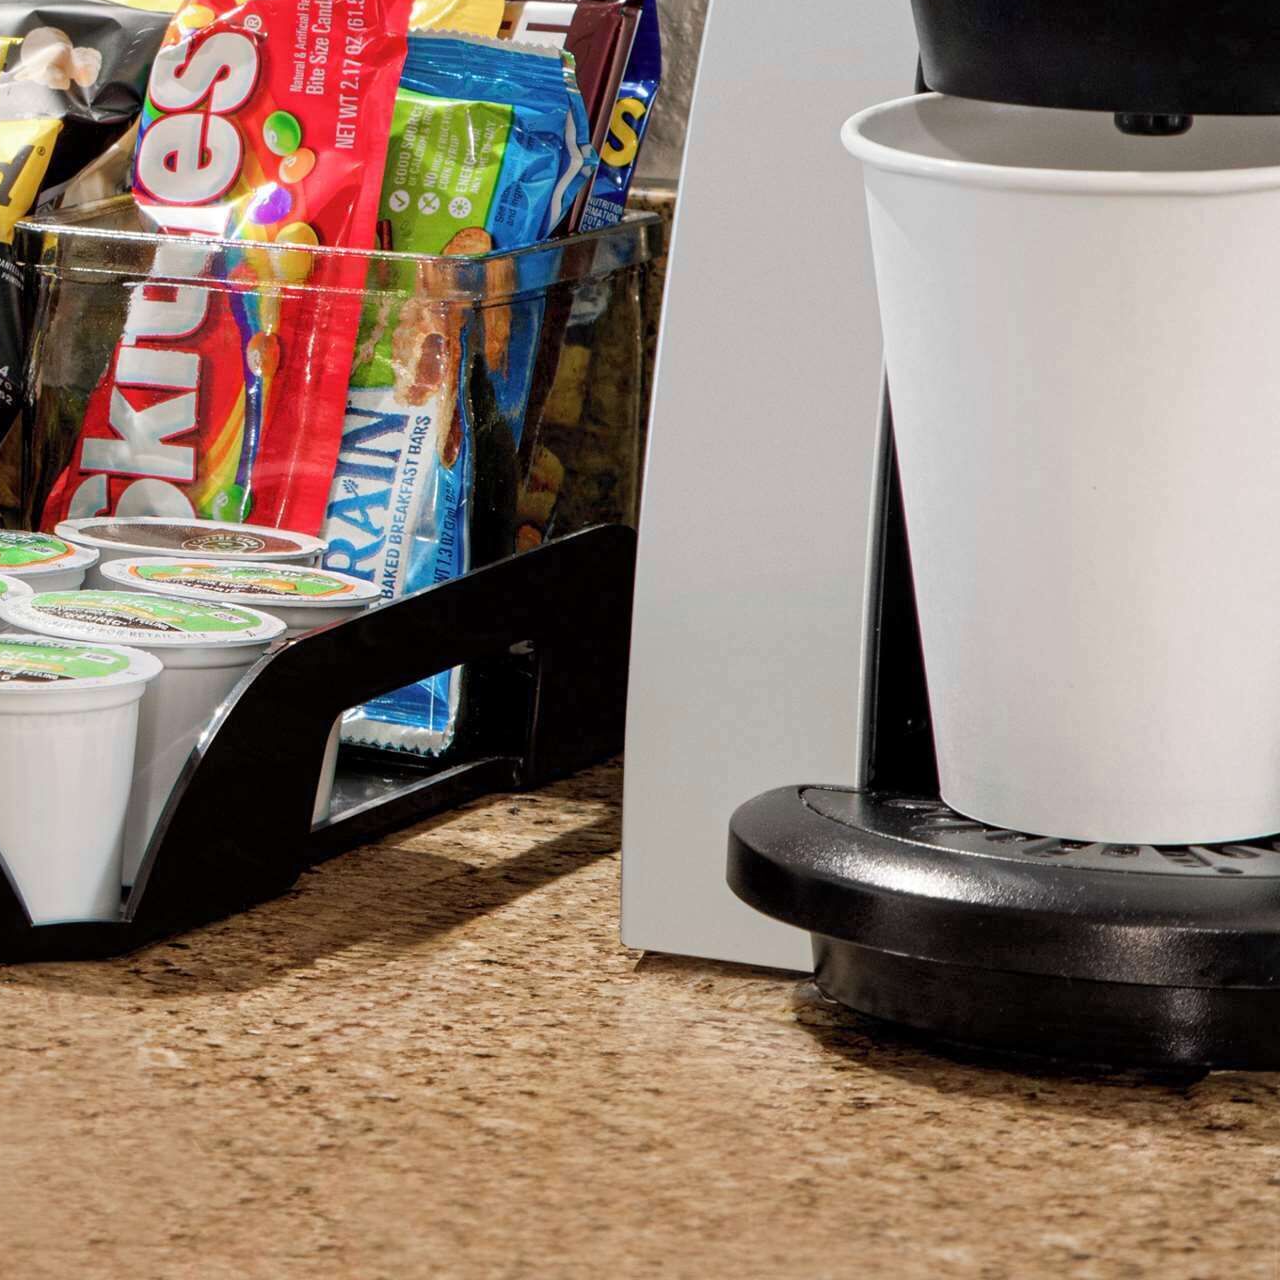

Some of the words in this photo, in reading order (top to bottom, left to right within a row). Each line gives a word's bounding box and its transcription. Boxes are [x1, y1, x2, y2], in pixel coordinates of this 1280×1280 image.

[310, 37, 329, 65] Size
[346, 32, 364, 55] OZ
[306, 67, 325, 95] Bite
[341, 56, 361, 91] 2.17
[340, 94, 357, 122] WT
[336, 124, 354, 150] NET
[393, 151, 411, 185] GOOD
[424, 172, 437, 188] NO
[408, 415, 432, 457] BARS
[391, 459, 420, 545] BREAKFAST
[381, 534, 402, 600] BAKED
